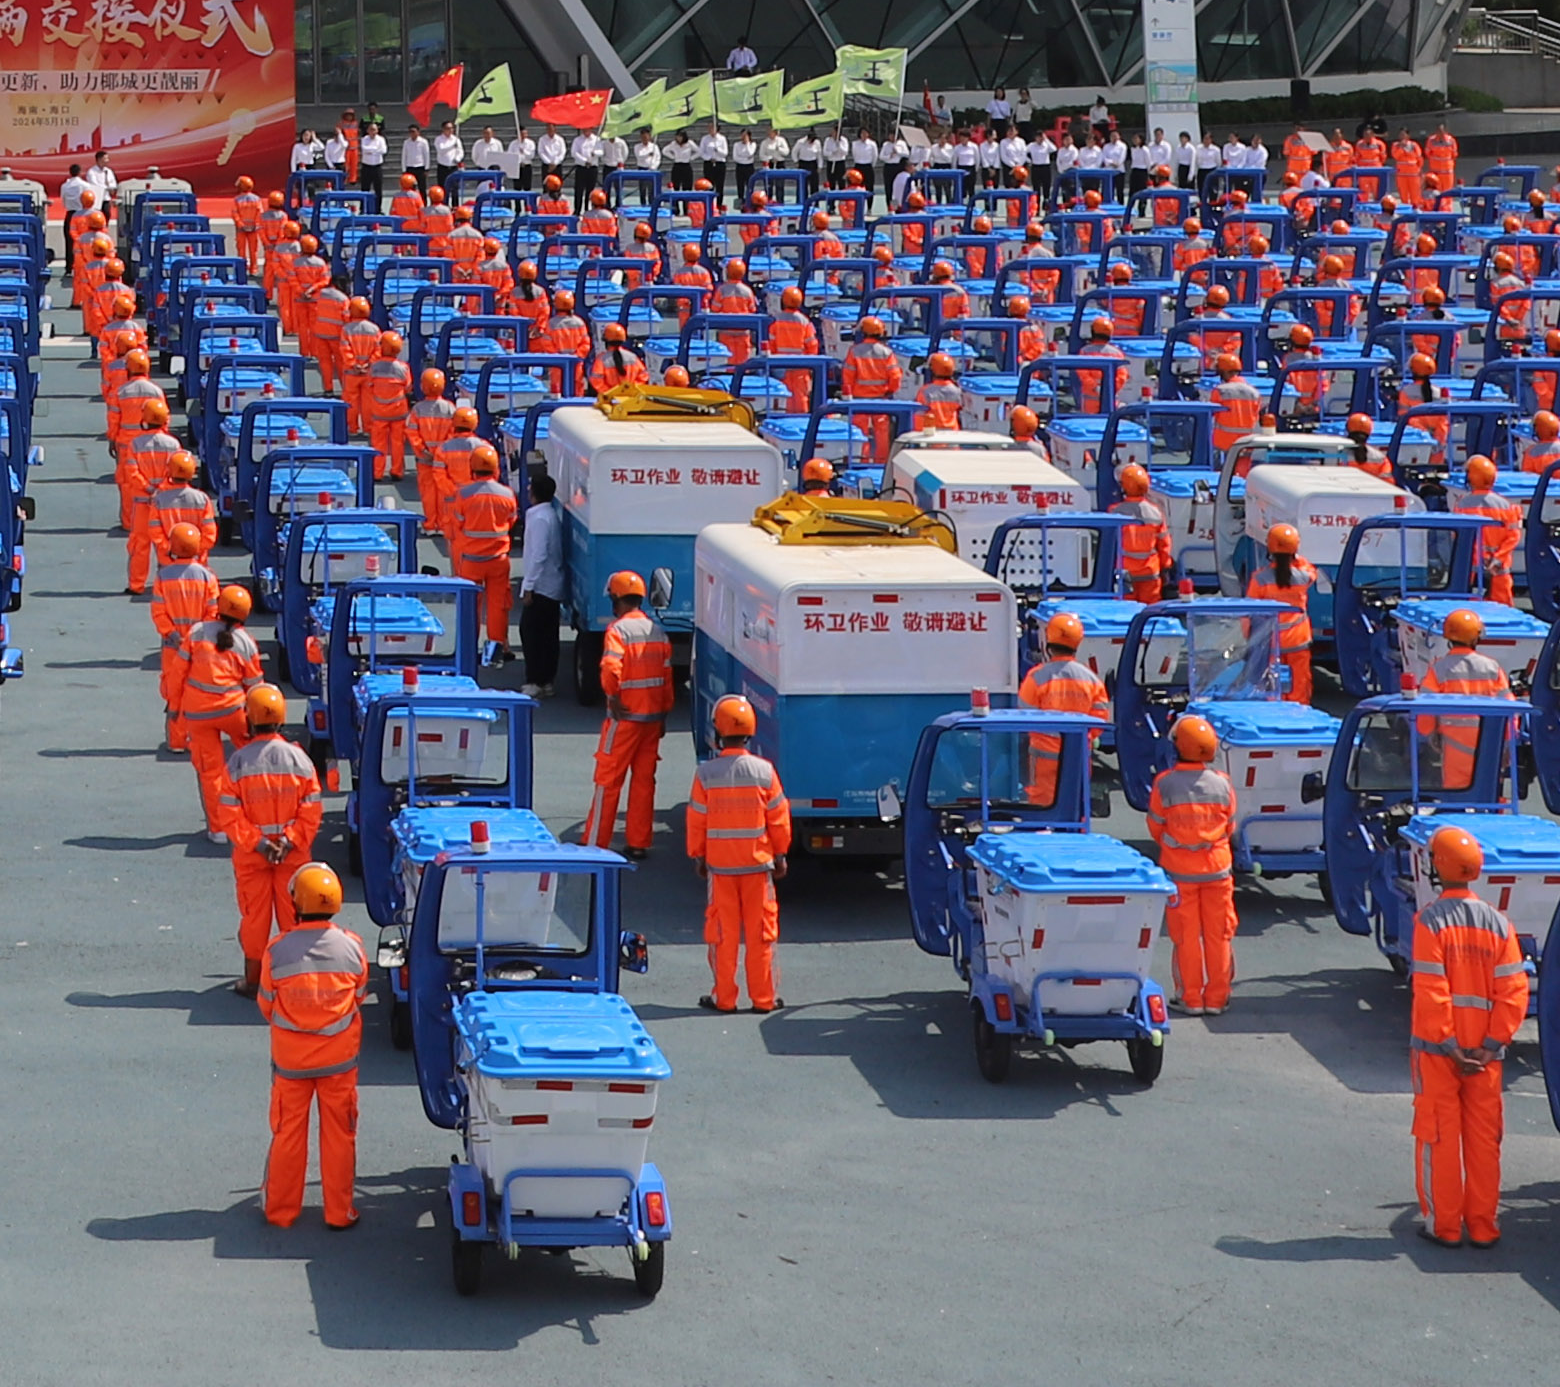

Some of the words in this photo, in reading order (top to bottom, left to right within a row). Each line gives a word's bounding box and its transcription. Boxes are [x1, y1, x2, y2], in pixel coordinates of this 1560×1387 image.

[12, 116, 80, 127] 2024年5月18日
[611, 468, 681, 485] 环卫作业
[691, 468, 760, 486] 敬请避让
[951, 491, 1008, 505] 环卫作业
[1340, 532, 1383, 548] 257
[803, 611, 890, 632] 环卫作业
[902, 611, 988, 632] 敬请避让
